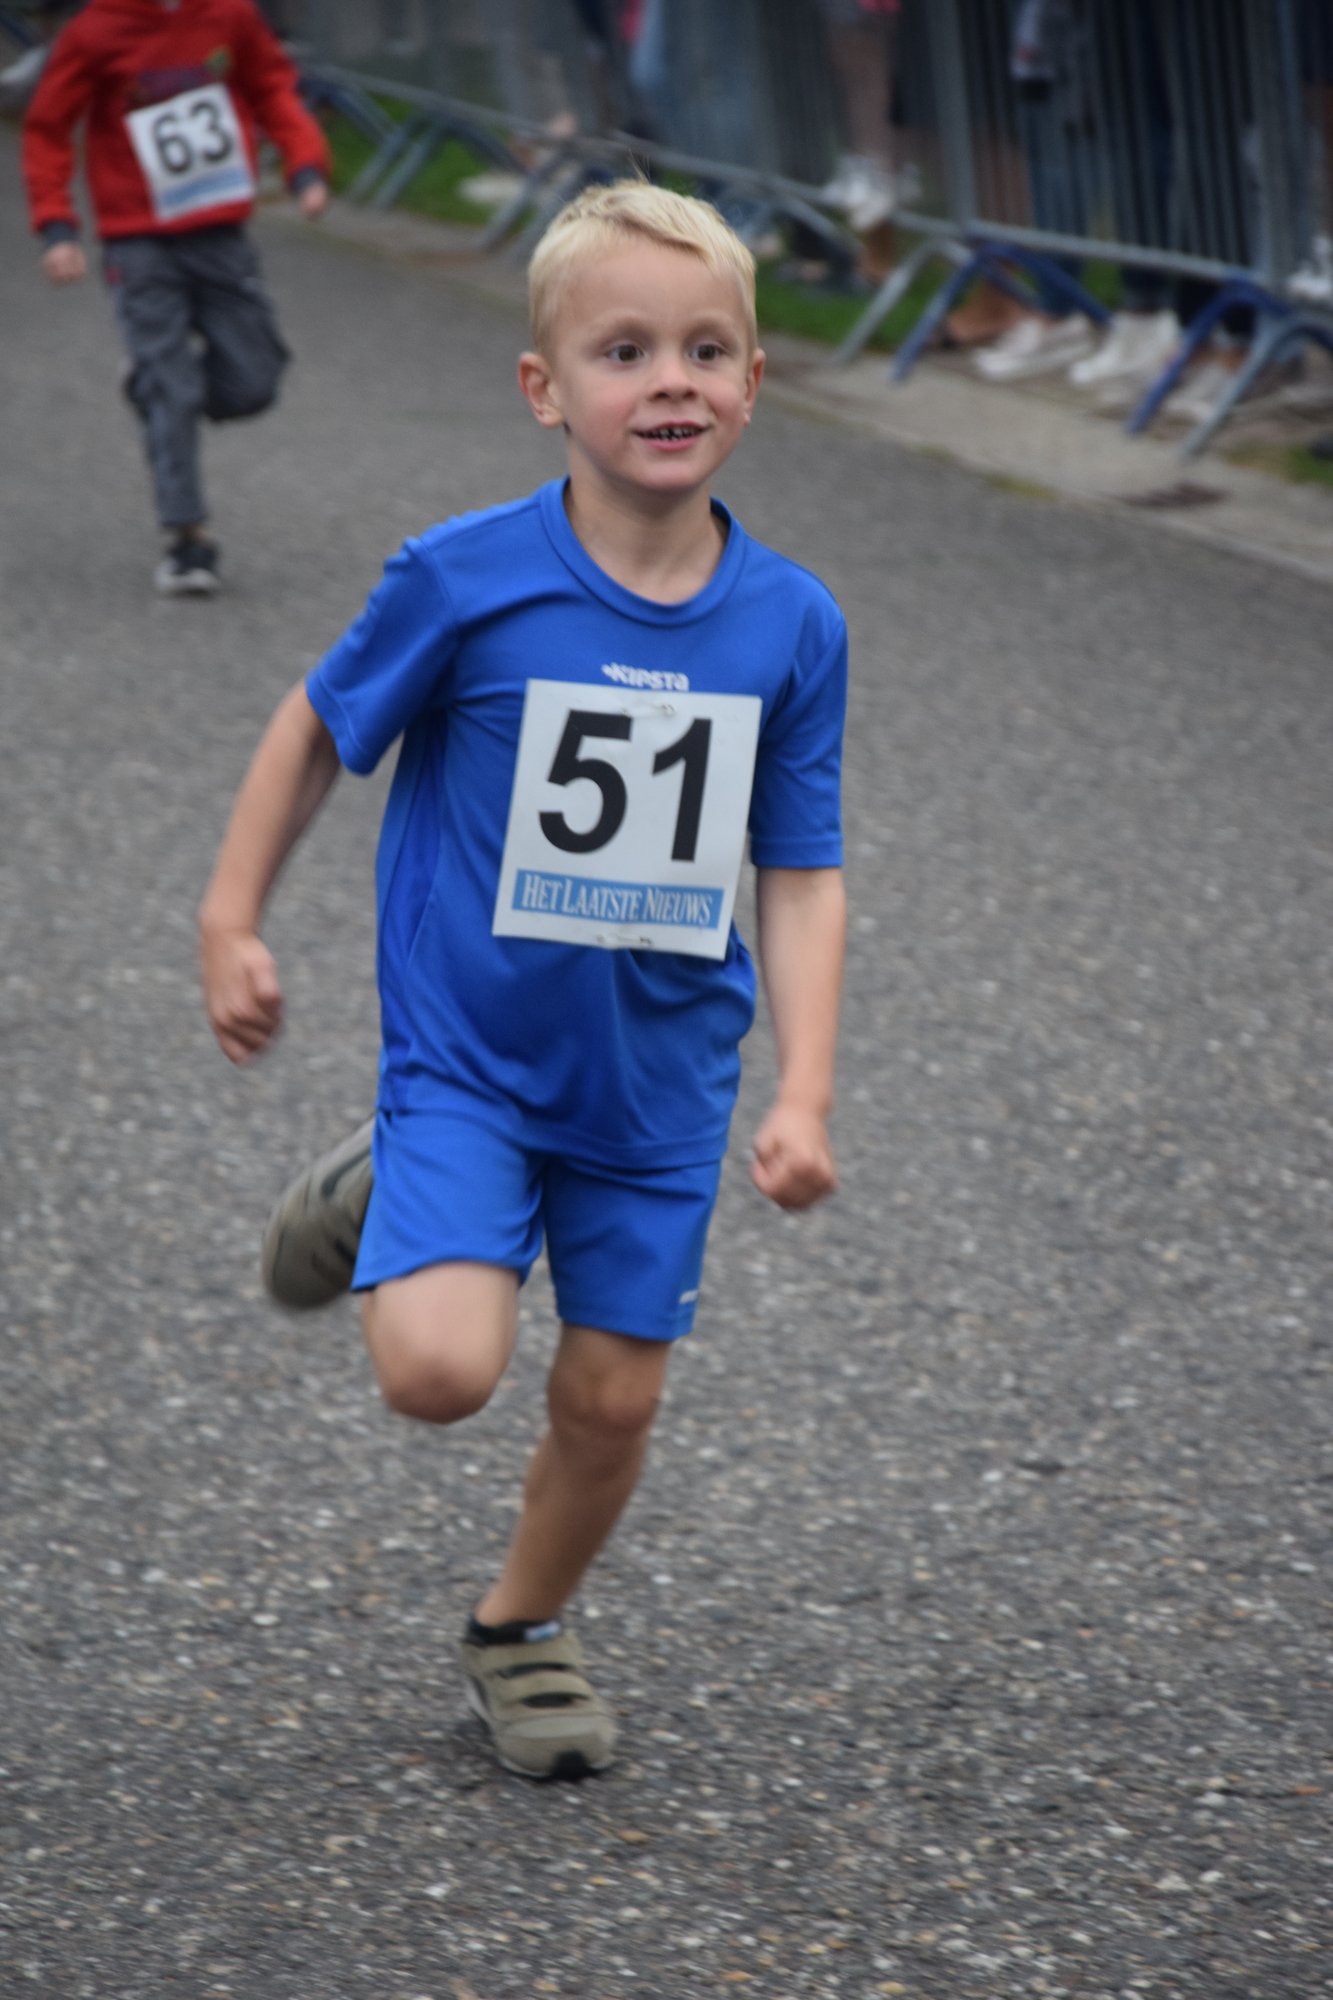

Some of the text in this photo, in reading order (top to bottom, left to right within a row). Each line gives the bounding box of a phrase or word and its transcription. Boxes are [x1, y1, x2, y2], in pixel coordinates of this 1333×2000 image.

[152, 101, 234, 175] 63
[538, 709, 712, 862] 51
[522, 874, 713, 925] HET LAATSTE NIEUWS
